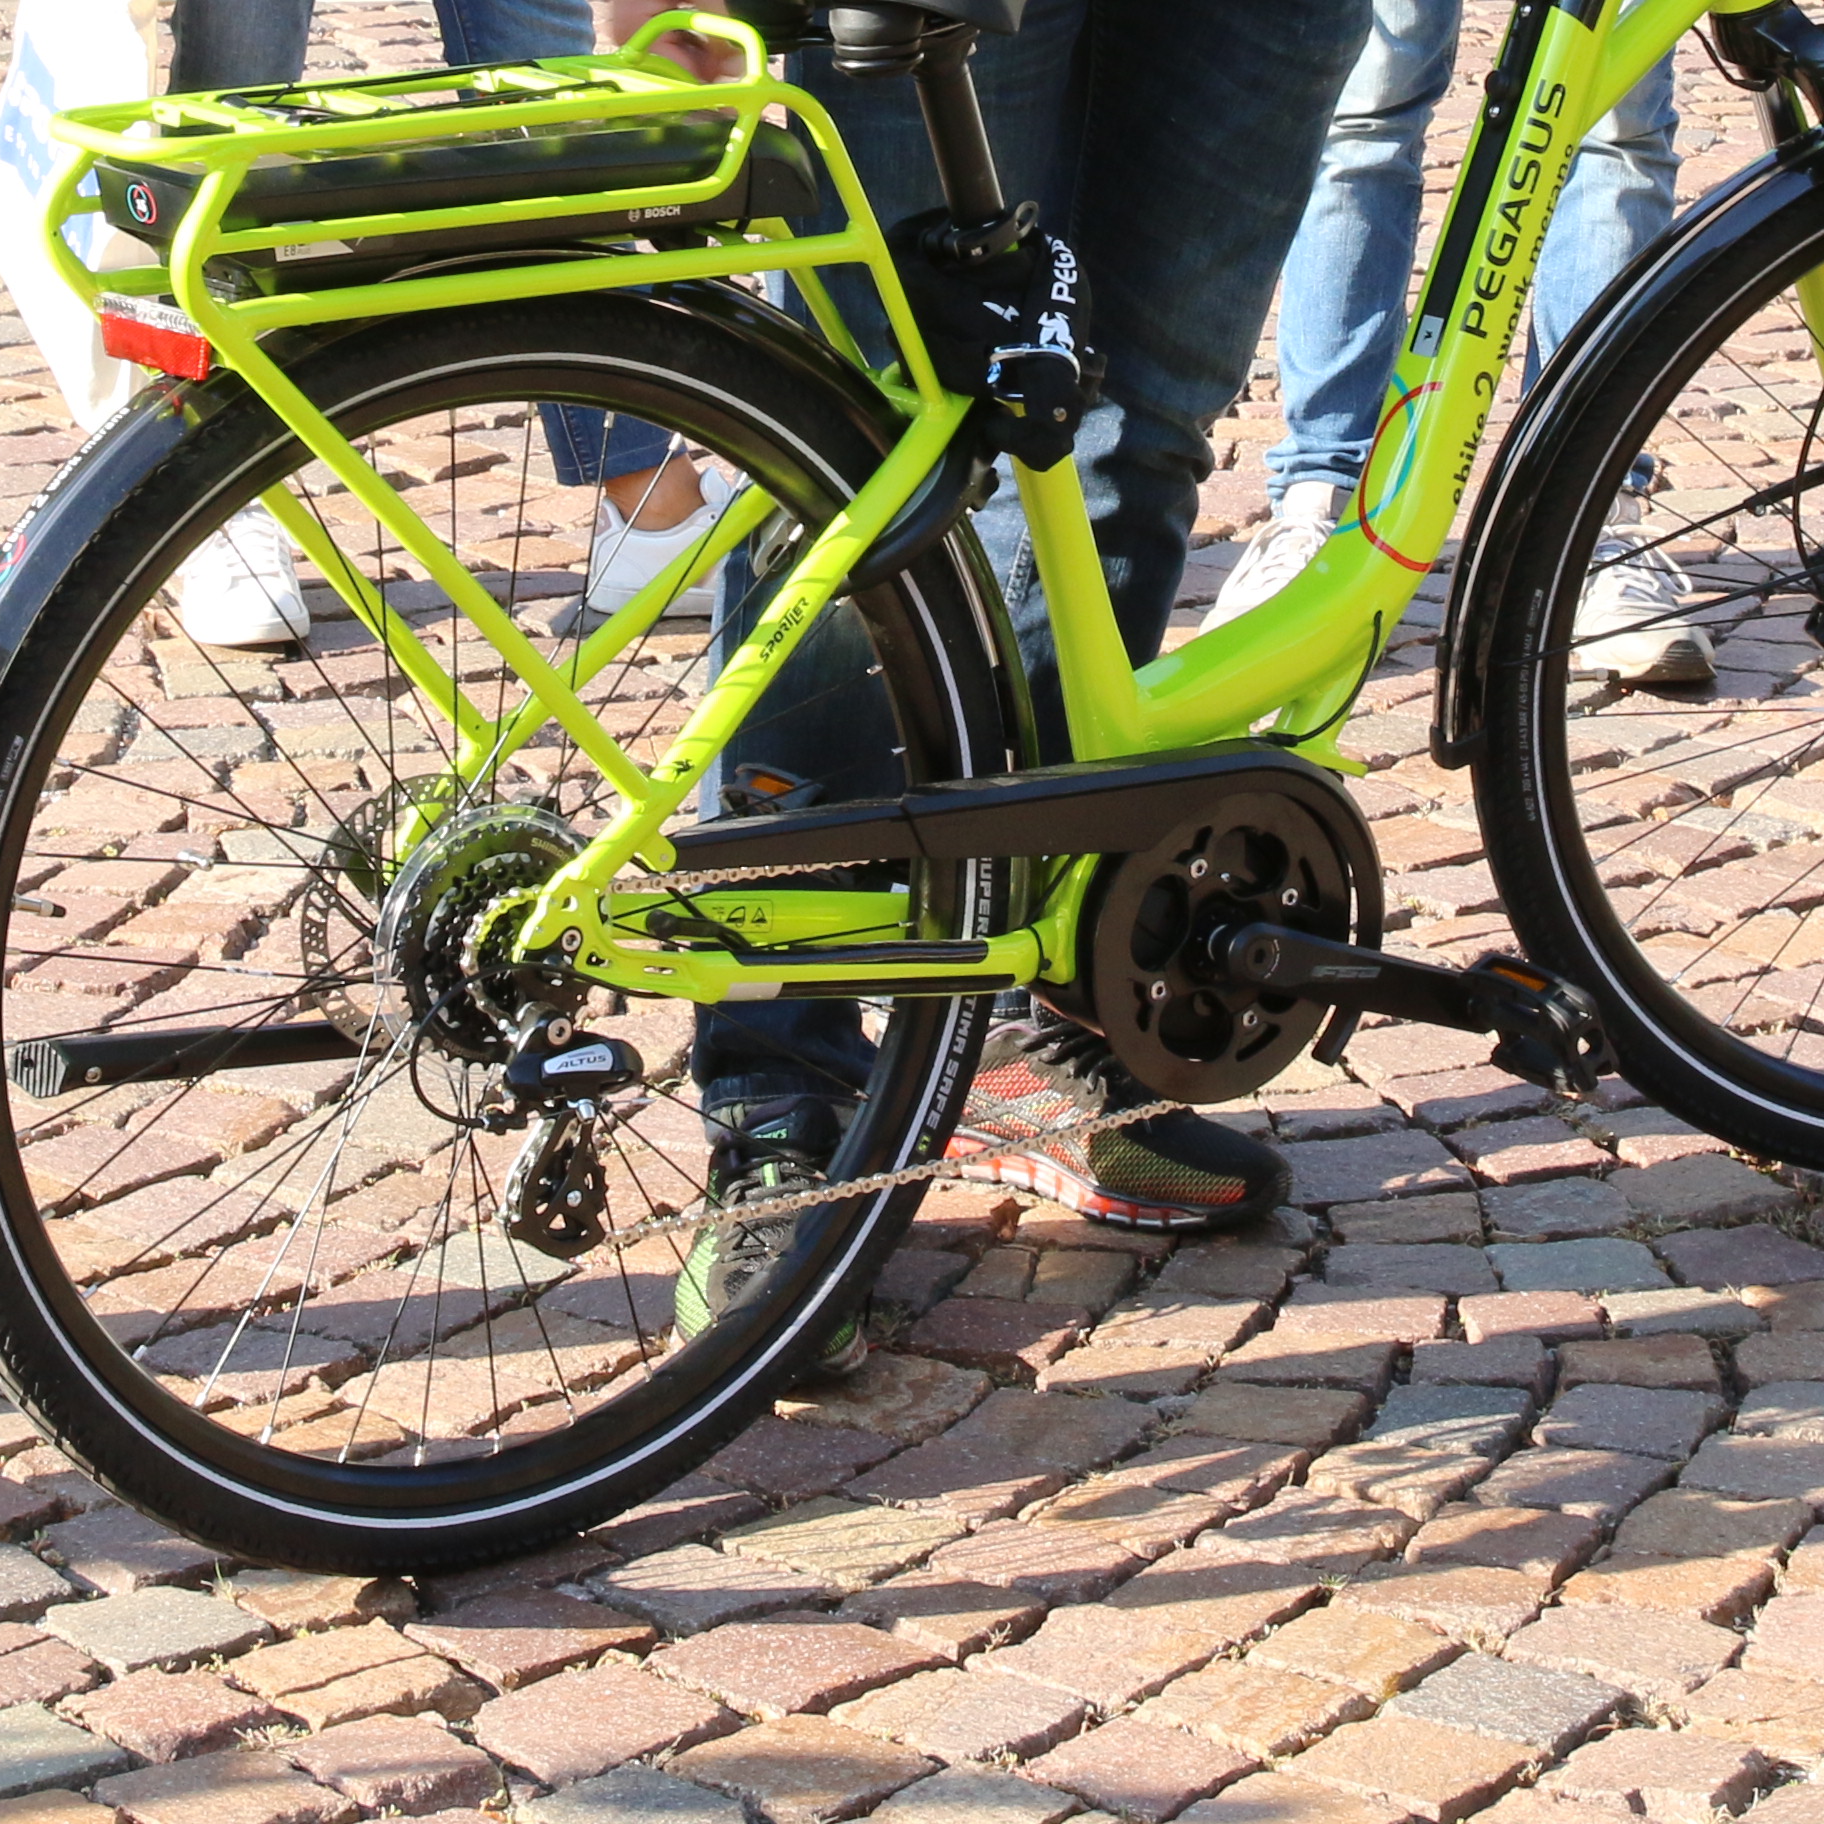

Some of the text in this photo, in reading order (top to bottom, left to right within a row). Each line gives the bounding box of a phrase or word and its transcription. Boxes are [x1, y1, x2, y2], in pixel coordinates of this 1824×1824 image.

[644, 205, 681, 219] BOSCH
[1460, 79, 1567, 339] PEGASUS
[1452, 412, 1485, 507] ebike
[1473, 370, 1495, 400] 2
[32, 493, 50, 509] 2
[46, 456, 83, 492] work
[759, 597, 810, 663] SPORTLER
[976, 857, 992, 939] UPER
[556, 1055, 607, 1070] ALTUS
[926, 1060, 960, 1130] SAFE
